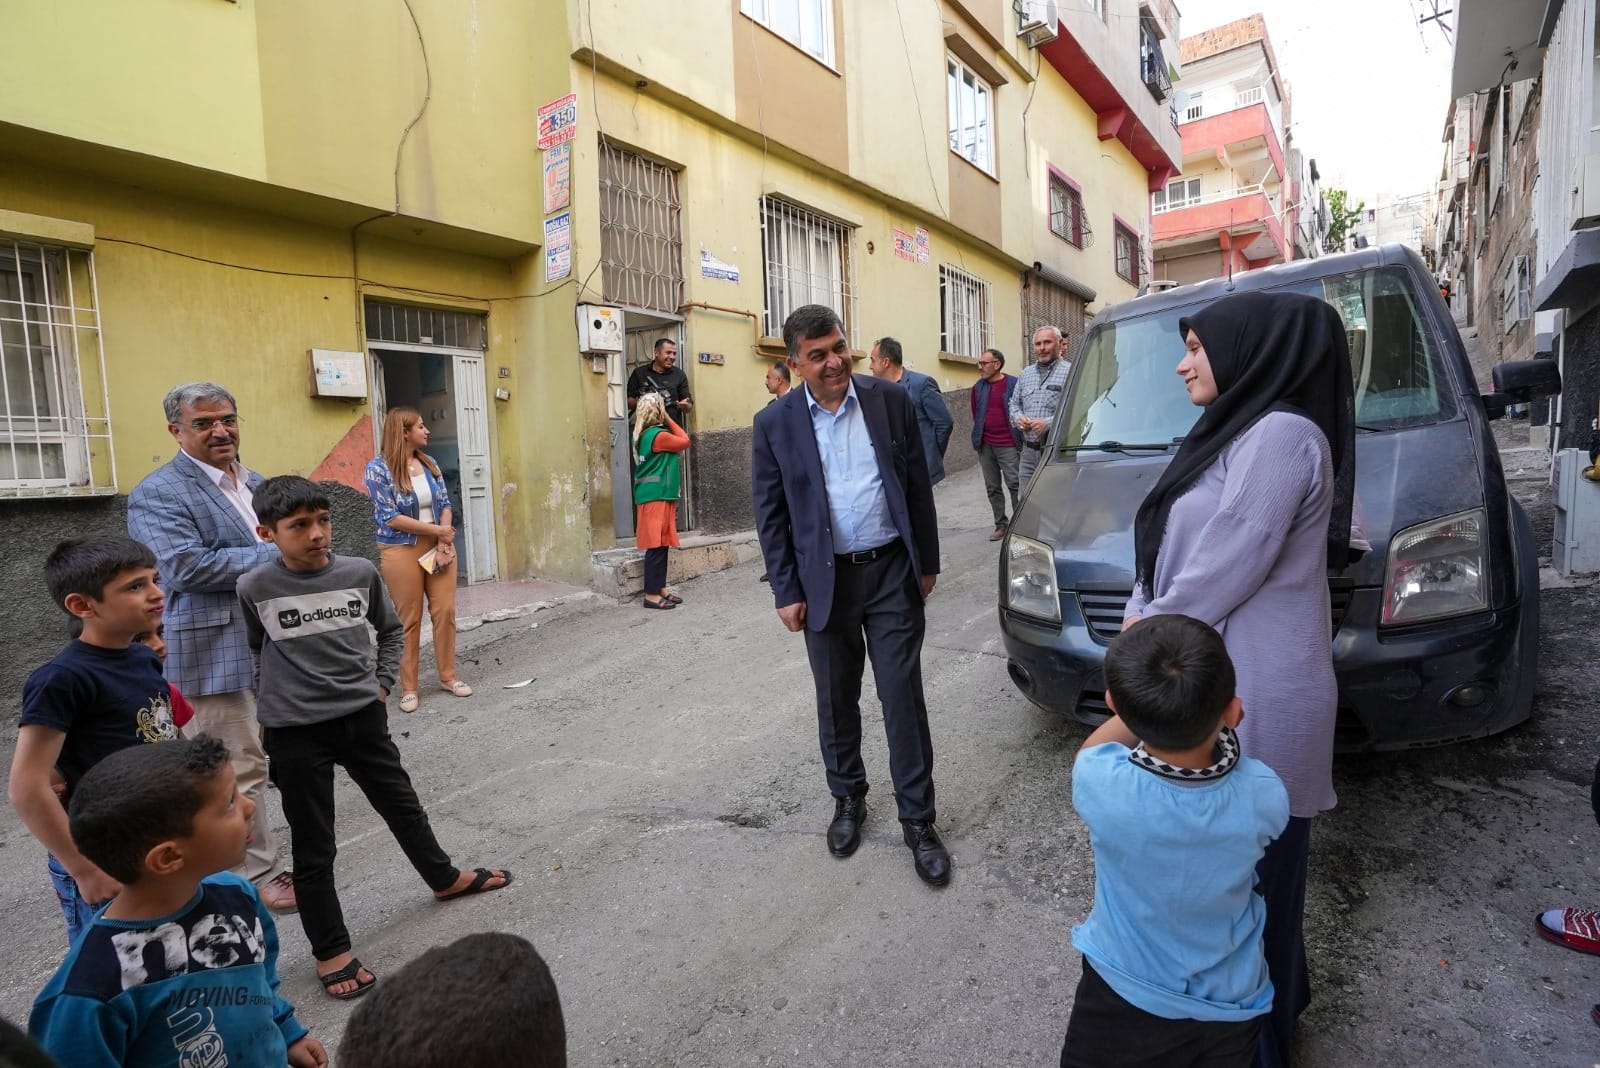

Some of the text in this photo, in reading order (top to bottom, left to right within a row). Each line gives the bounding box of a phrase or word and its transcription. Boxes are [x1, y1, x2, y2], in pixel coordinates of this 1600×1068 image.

[554, 108, 574, 129] 350
[303, 607, 348, 622] adidas
[163, 986, 248, 1009] MOVING
